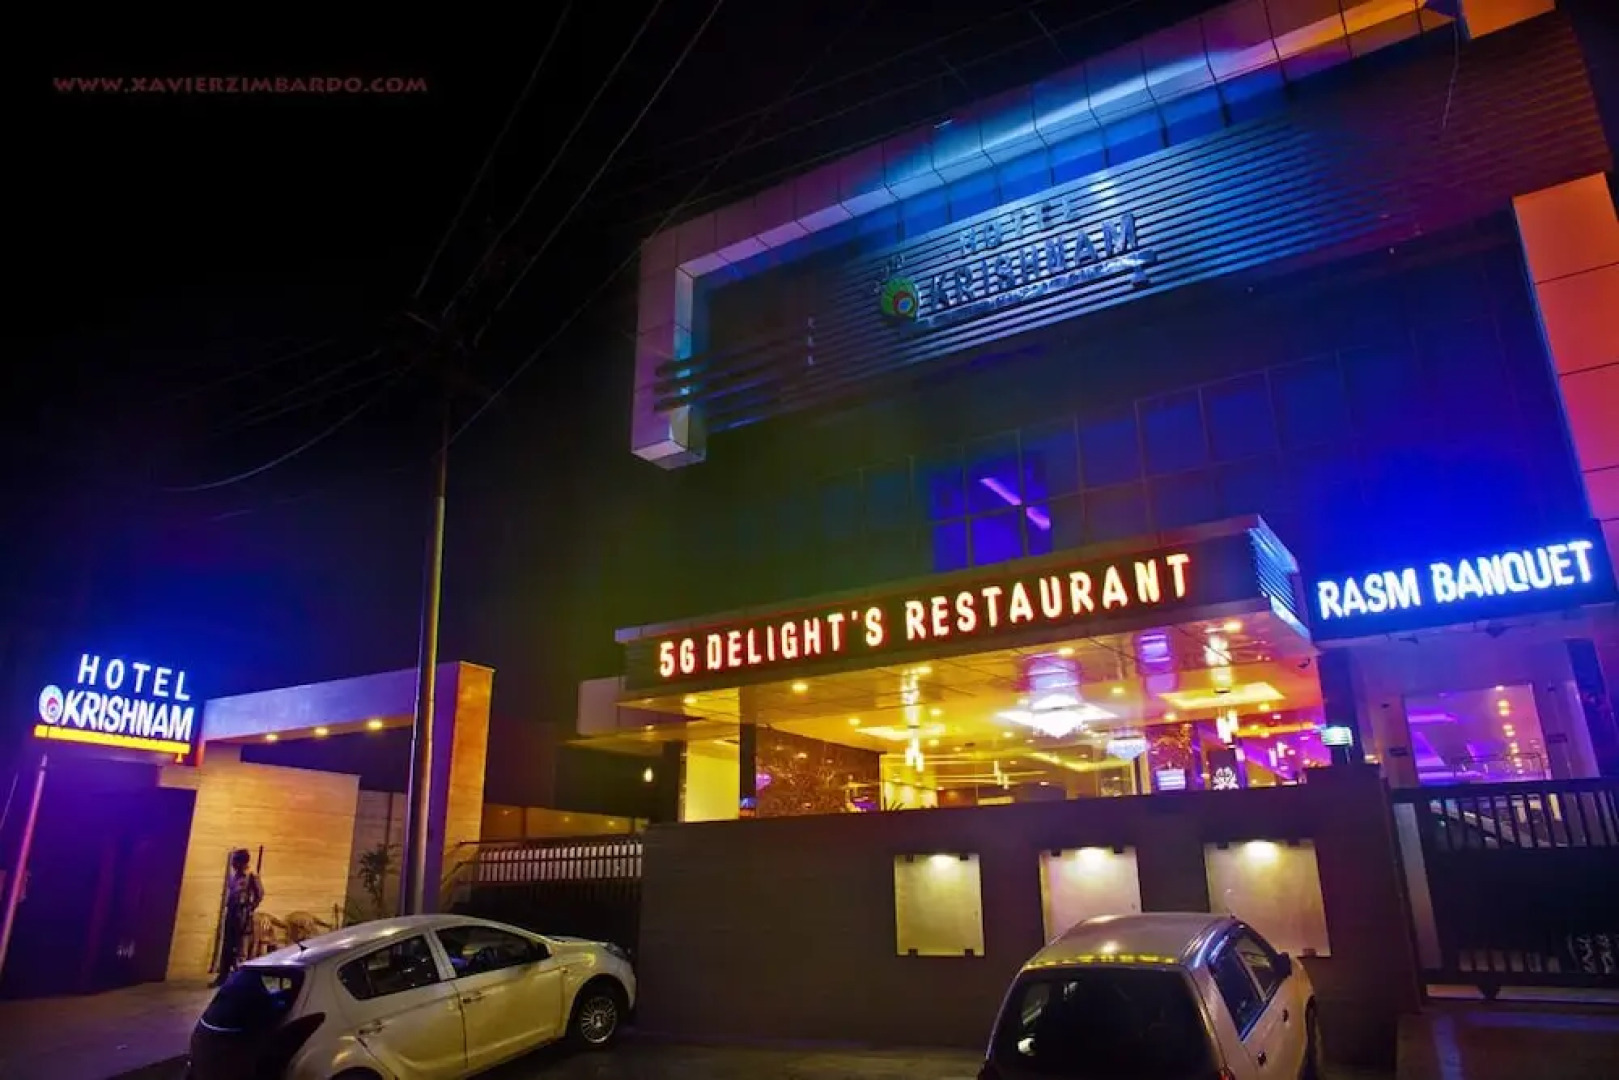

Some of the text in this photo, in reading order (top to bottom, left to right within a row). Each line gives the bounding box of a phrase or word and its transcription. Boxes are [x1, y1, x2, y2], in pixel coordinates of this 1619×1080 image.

[931, 212, 1140, 310] KRISHNAM
[959, 197, 1074, 258] HOTEL
[706, 606, 884, 670] DELIGHT'S
[904, 553, 1190, 640] RESTAURANT
[1316, 540, 1593, 620] RASM BANQUET
[77, 653, 191, 701] HOTEL
[61, 689, 195, 741] KRISHNAM
